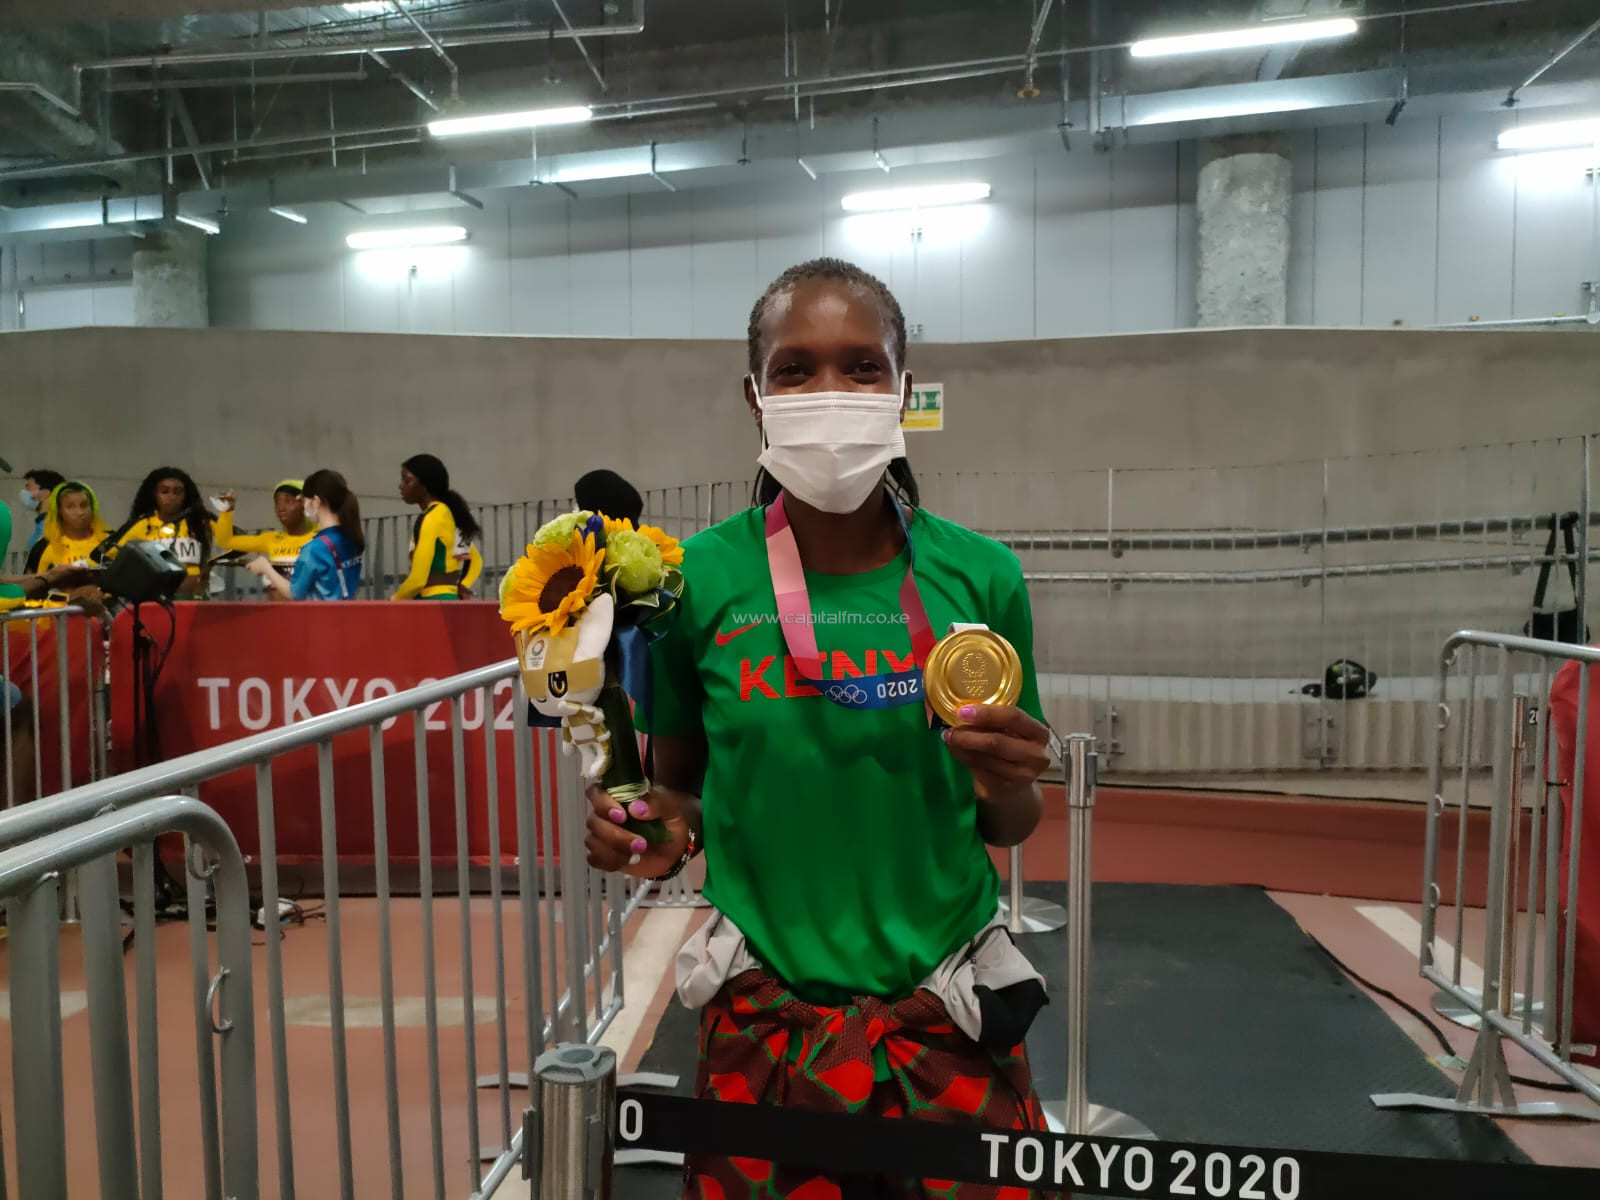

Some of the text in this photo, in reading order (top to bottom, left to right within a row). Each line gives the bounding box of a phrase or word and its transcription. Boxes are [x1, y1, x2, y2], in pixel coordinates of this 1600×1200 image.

[740, 649, 915, 701] KENY
[876, 678, 918, 699] 2020
[197, 677, 397, 730] TOKYO
[980, 1133, 1300, 1200] TOKYO 2020
